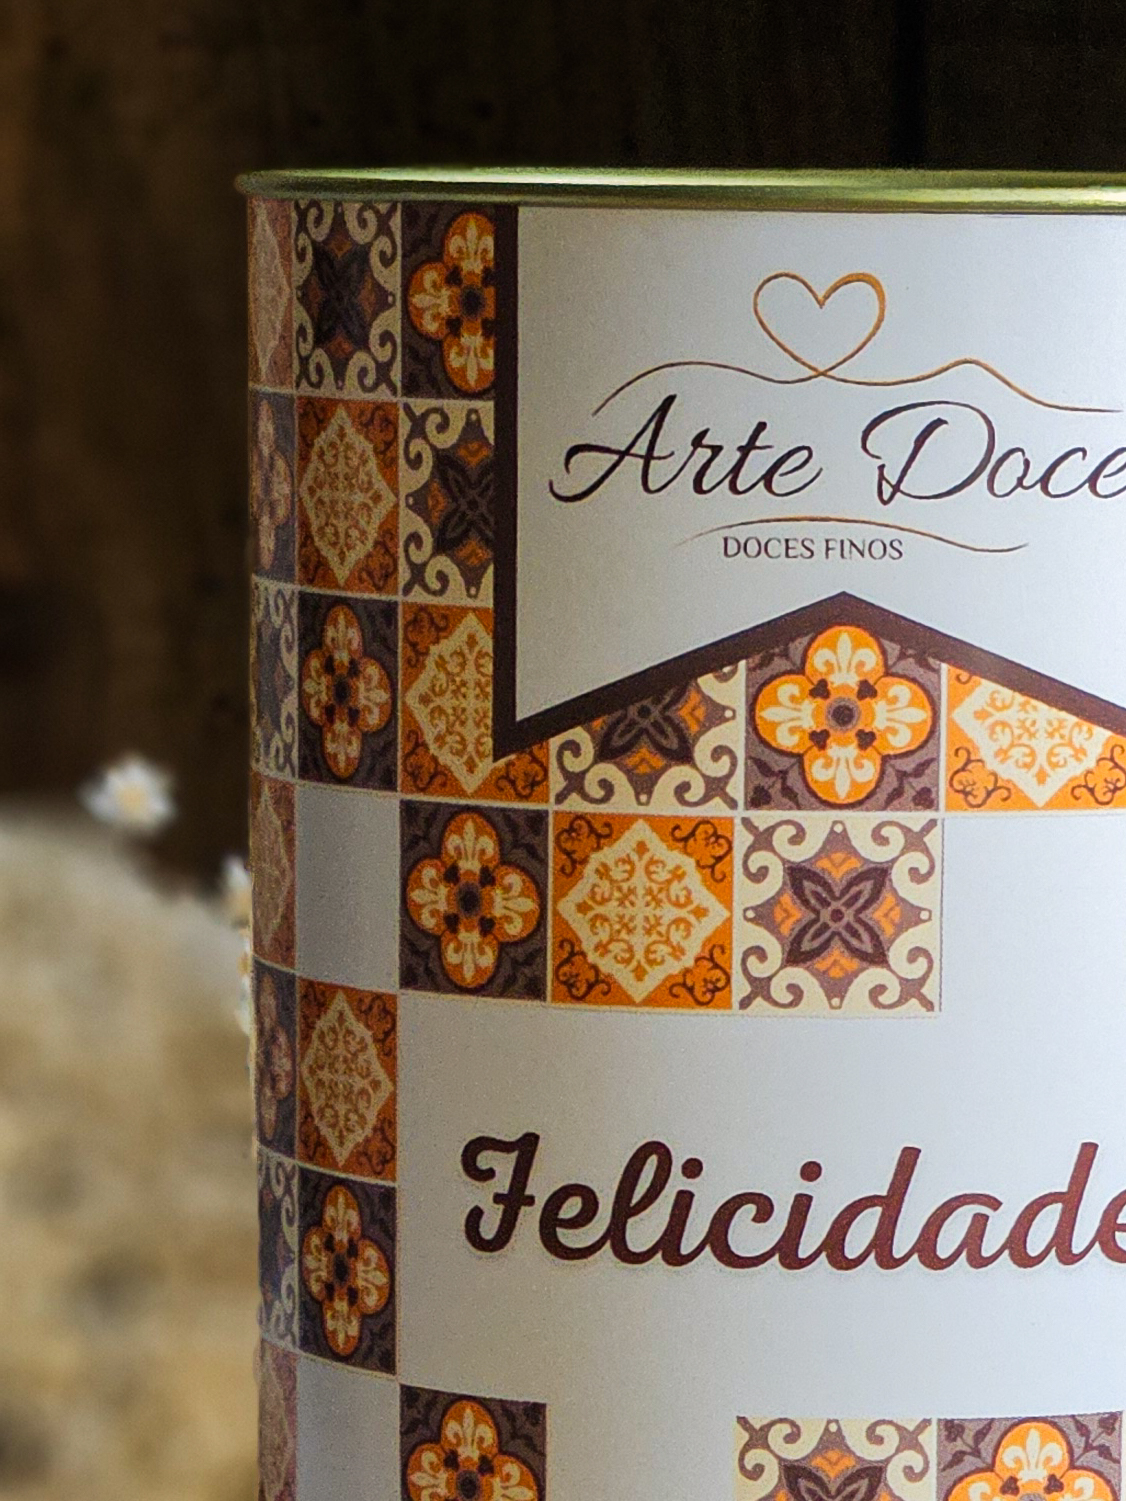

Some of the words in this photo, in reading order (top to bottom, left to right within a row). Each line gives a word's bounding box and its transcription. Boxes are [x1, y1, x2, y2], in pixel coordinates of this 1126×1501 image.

[549, 394, 823, 503] Arte
[722, 536, 815, 560] DOCES
[823, 537, 904, 562] FINOS
